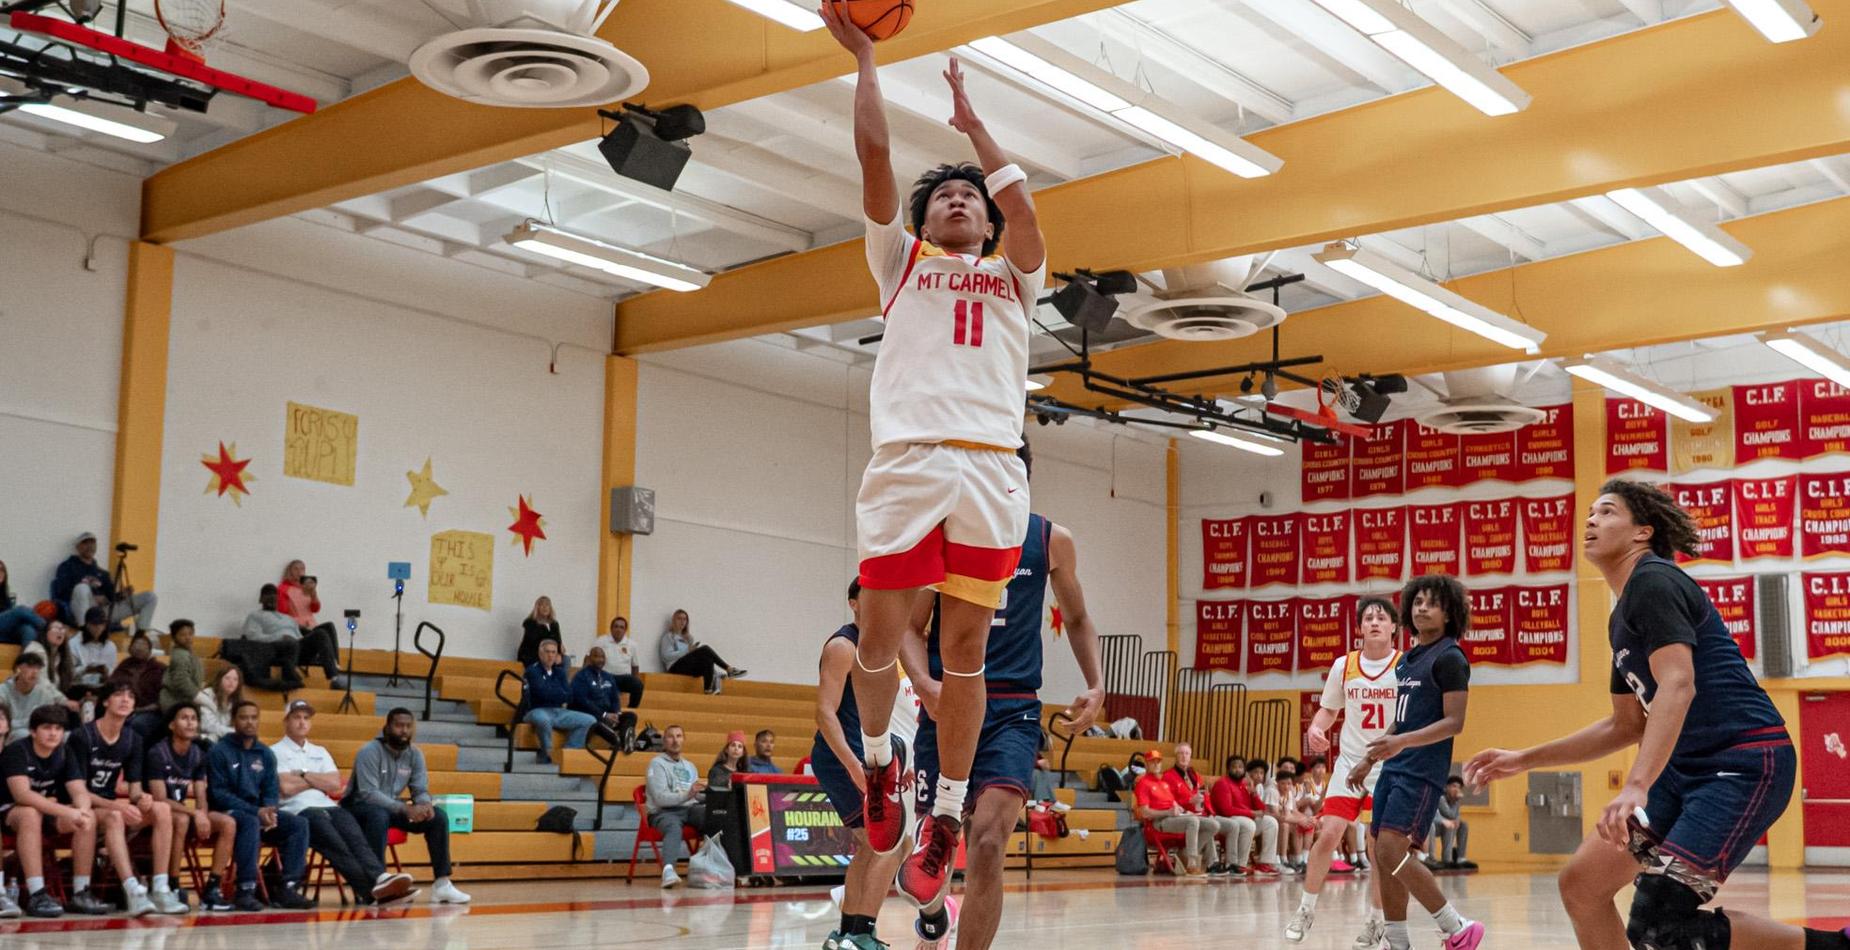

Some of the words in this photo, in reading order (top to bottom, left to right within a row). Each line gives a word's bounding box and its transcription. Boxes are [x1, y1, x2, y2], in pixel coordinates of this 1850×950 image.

[918, 272, 945, 291] MT
[949, 272, 1015, 303] CARMEL
[953, 299, 984, 348] 11
[1755, 419, 1779, 430] GOLF
[1743, 429, 1791, 445] CHAMPIONS
[1612, 442, 1660, 456] CHAMPIONS
[1465, 453, 1511, 467] CHAMPIONS
[1521, 449, 1568, 464] CHAMPIONS
[1411, 458, 1454, 473] CHAMPIONS
[1307, 469, 1346, 483] CHAMPIONS
[1359, 465, 1399, 481] CHAMPIONS
[1742, 527, 1788, 542] CHAMPIONS
[435, 537, 475, 560] THIS
[1471, 544, 1511, 559] CHAMPIONS
[1256, 551, 1294, 564] CHAMPIONS
[1307, 556, 1345, 570] CHAMPIONS
[1361, 552, 1399, 566] CHAMPIONS
[1415, 550, 1457, 564] CHAMPIONS
[1302, 635, 1341, 648] CHAMPIONS
[1517, 631, 1564, 644] CHAMPIONS
[1202, 642, 1236, 655] CHAMPIONS
[1253, 641, 1290, 655] CHAMPIONS
[1347, 688, 1359, 699] MT
[1361, 687, 1397, 700] CARMEL
[1361, 703, 1385, 729] 21
[786, 828, 810, 841] #25
